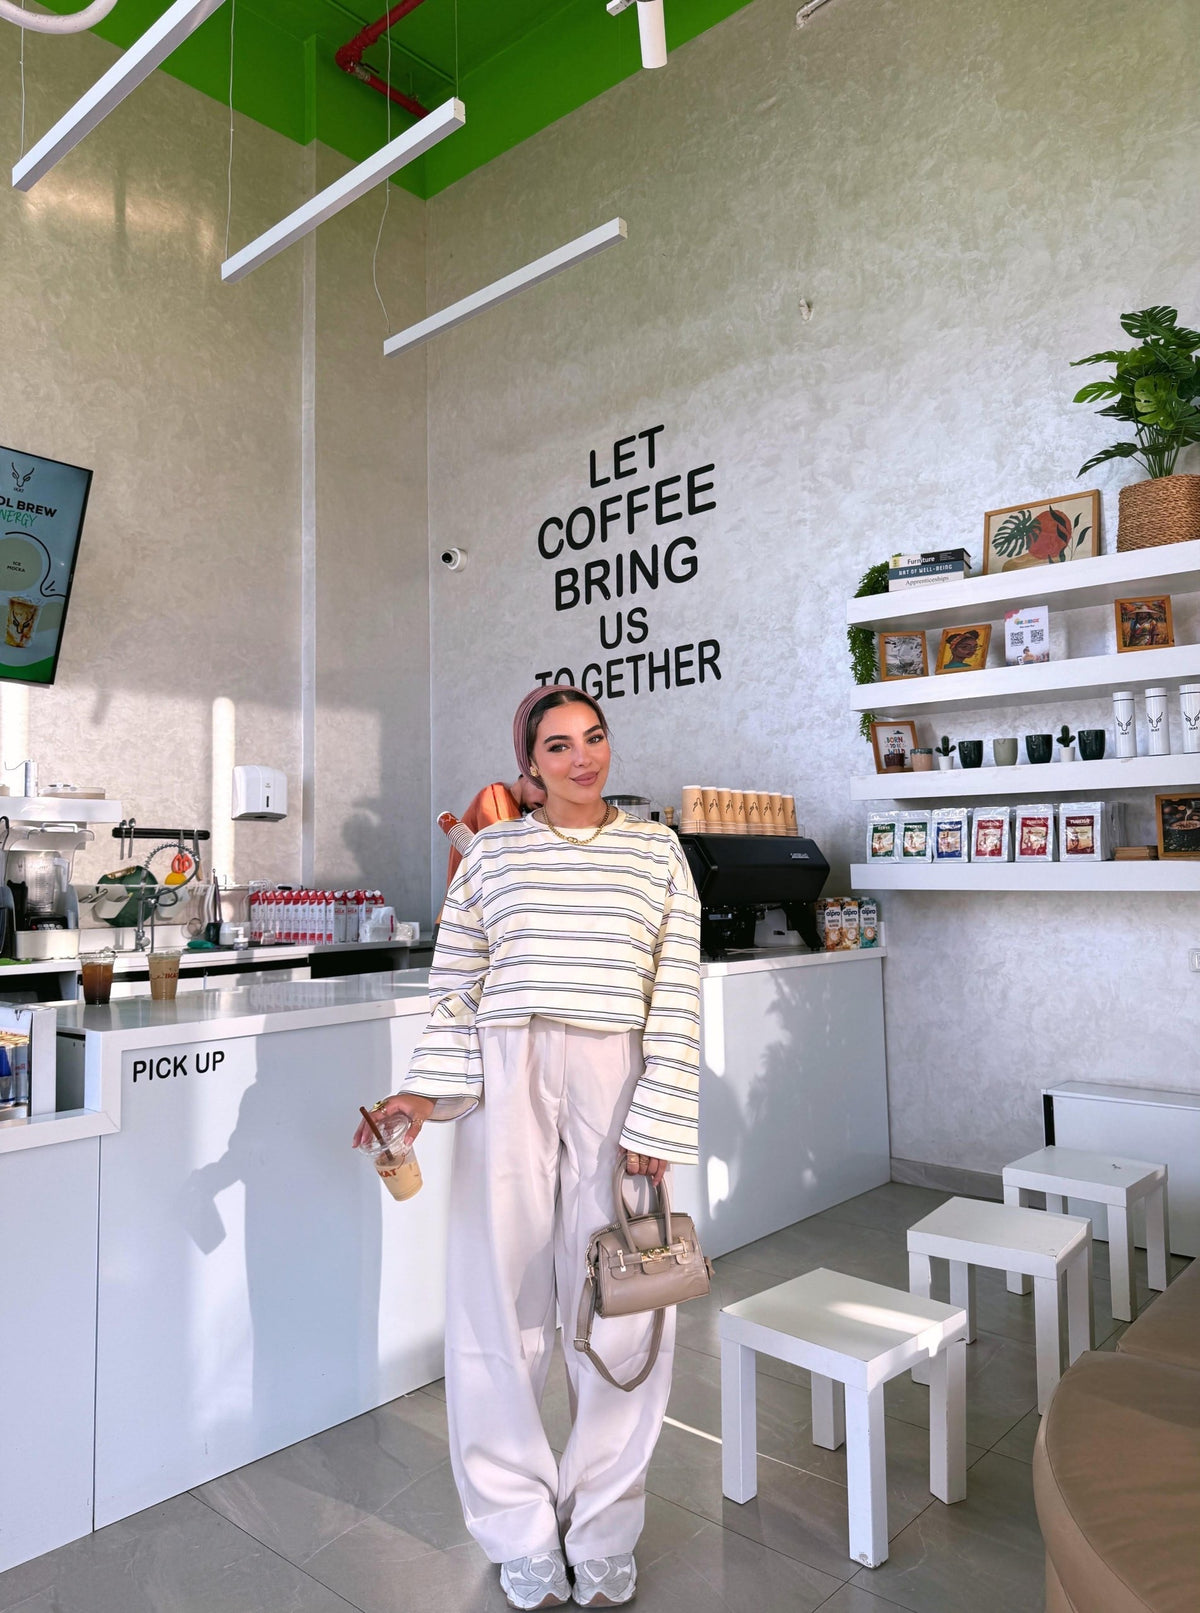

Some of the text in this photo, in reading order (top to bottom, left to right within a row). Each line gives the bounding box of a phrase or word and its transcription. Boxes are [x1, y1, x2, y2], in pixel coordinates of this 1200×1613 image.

[589, 424, 665, 489] LET
[16, 499, 58, 518] BREW
[537, 463, 717, 560] COFFEE
[555, 536, 698, 612] BRING
[907, 556, 936, 566] Furniture
[919, 564, 953, 573] WELL-BEING
[905, 576, 950, 586] Apprenticeships
[600, 606, 649, 650] US
[826, 909, 840, 917] alpro
[132, 1050, 225, 1083] PICK UP
